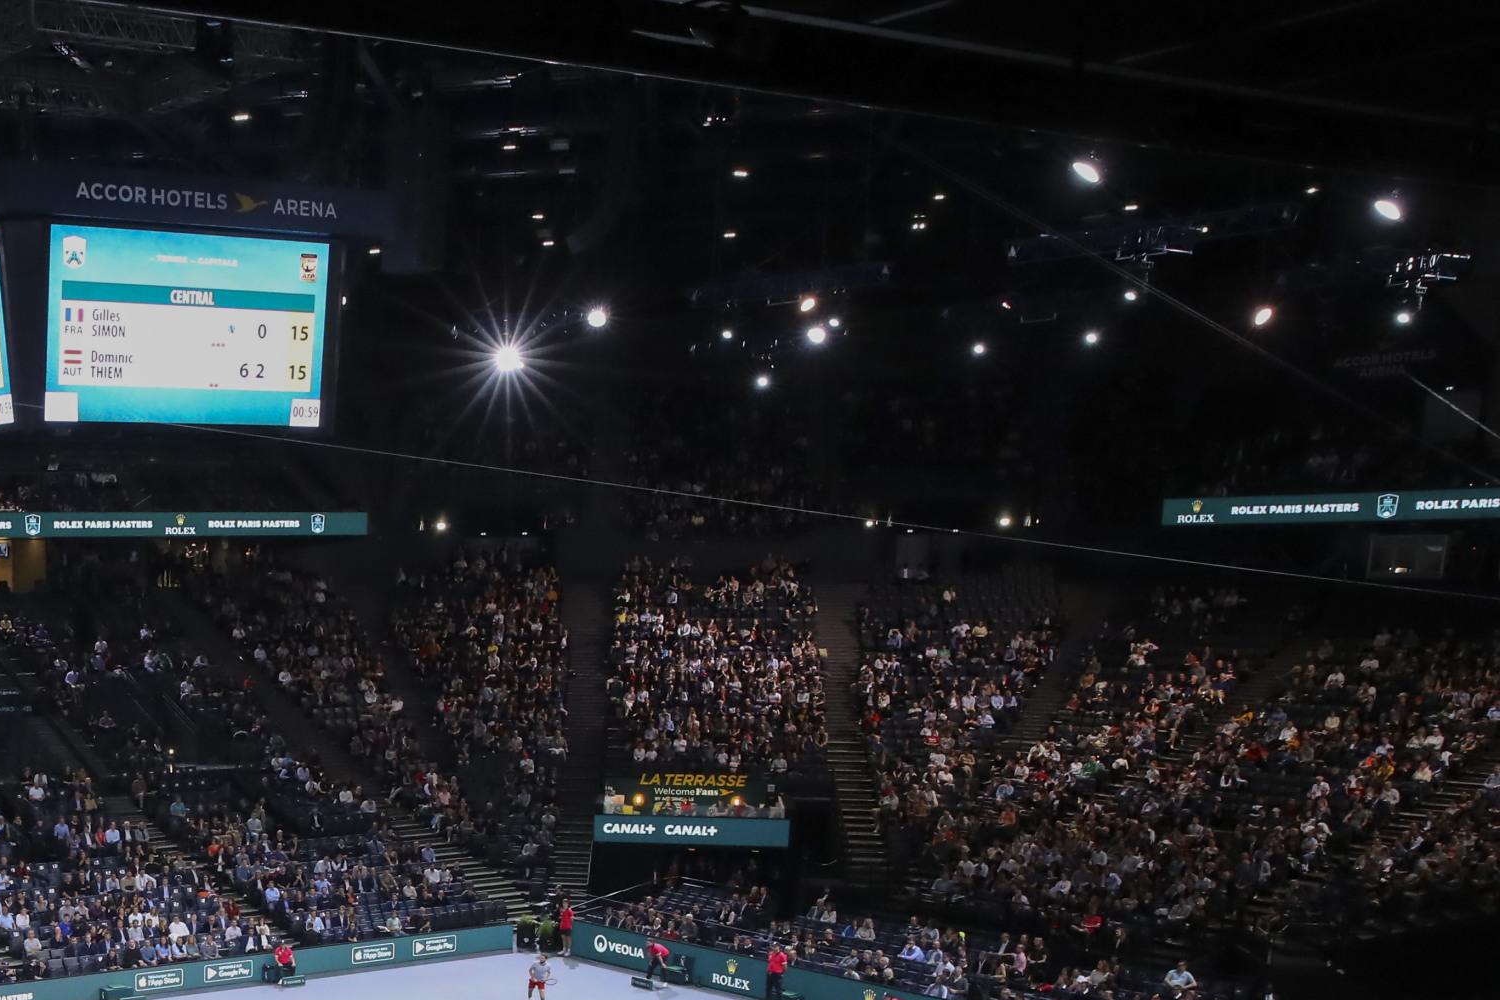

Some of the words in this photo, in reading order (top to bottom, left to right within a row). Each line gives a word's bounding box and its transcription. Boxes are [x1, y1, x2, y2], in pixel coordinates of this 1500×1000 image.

[76, 182, 147, 204] ACCOR
[152, 189, 228, 210] HOTELS
[273, 199, 337, 219] ARENA
[169, 290, 215, 306] CENTRAL
[92, 309, 121, 323] Gilles
[64, 325, 83, 335] FRA
[91, 324, 126, 338] SIMON
[257, 323, 267, 340] 0
[291, 326, 309, 341] 15
[91, 350, 133, 364] Dominic
[62, 367, 82, 376] AUT
[91, 366, 123, 379] THIEM
[239, 363, 249, 378] 6
[255, 363, 265, 379] 2
[289, 364, 307, 380] 15
[292, 406, 319, 419] 00:59
[1231, 505, 1268, 515] ROLEX
[1270, 504, 1303, 514] PARIS
[1305, 502, 1360, 513] MASTERS
[1416, 499, 1459, 510] ROLEX
[1462, 498, 1500, 509] PARIS
[54, 520, 83, 529] ROLEX
[85, 520, 111, 529] PARIS
[113, 520, 153, 529] MASTERS
[209, 520, 235, 528] ROLEX
[237, 520, 261, 528] PARIS
[263, 520, 300, 529] MASTERS
[1177, 513, 1214, 524] ROLEX
[165, 526, 196, 535] ROLEX
[639, 773, 661, 786] LA
[664, 774, 748, 787] TERRASSE
[654, 787, 695, 796] Welcome
[696, 788, 719, 796] Fans
[603, 823, 656, 835] CANAL+
[664, 824, 718, 837] CANAL+
[608, 942, 645, 959] VEOLIA
[218, 967, 239, 978] Google
[239, 967, 250, 976] Play
[164, 976, 181, 985] Store
[712, 972, 750, 991] ROLEX
